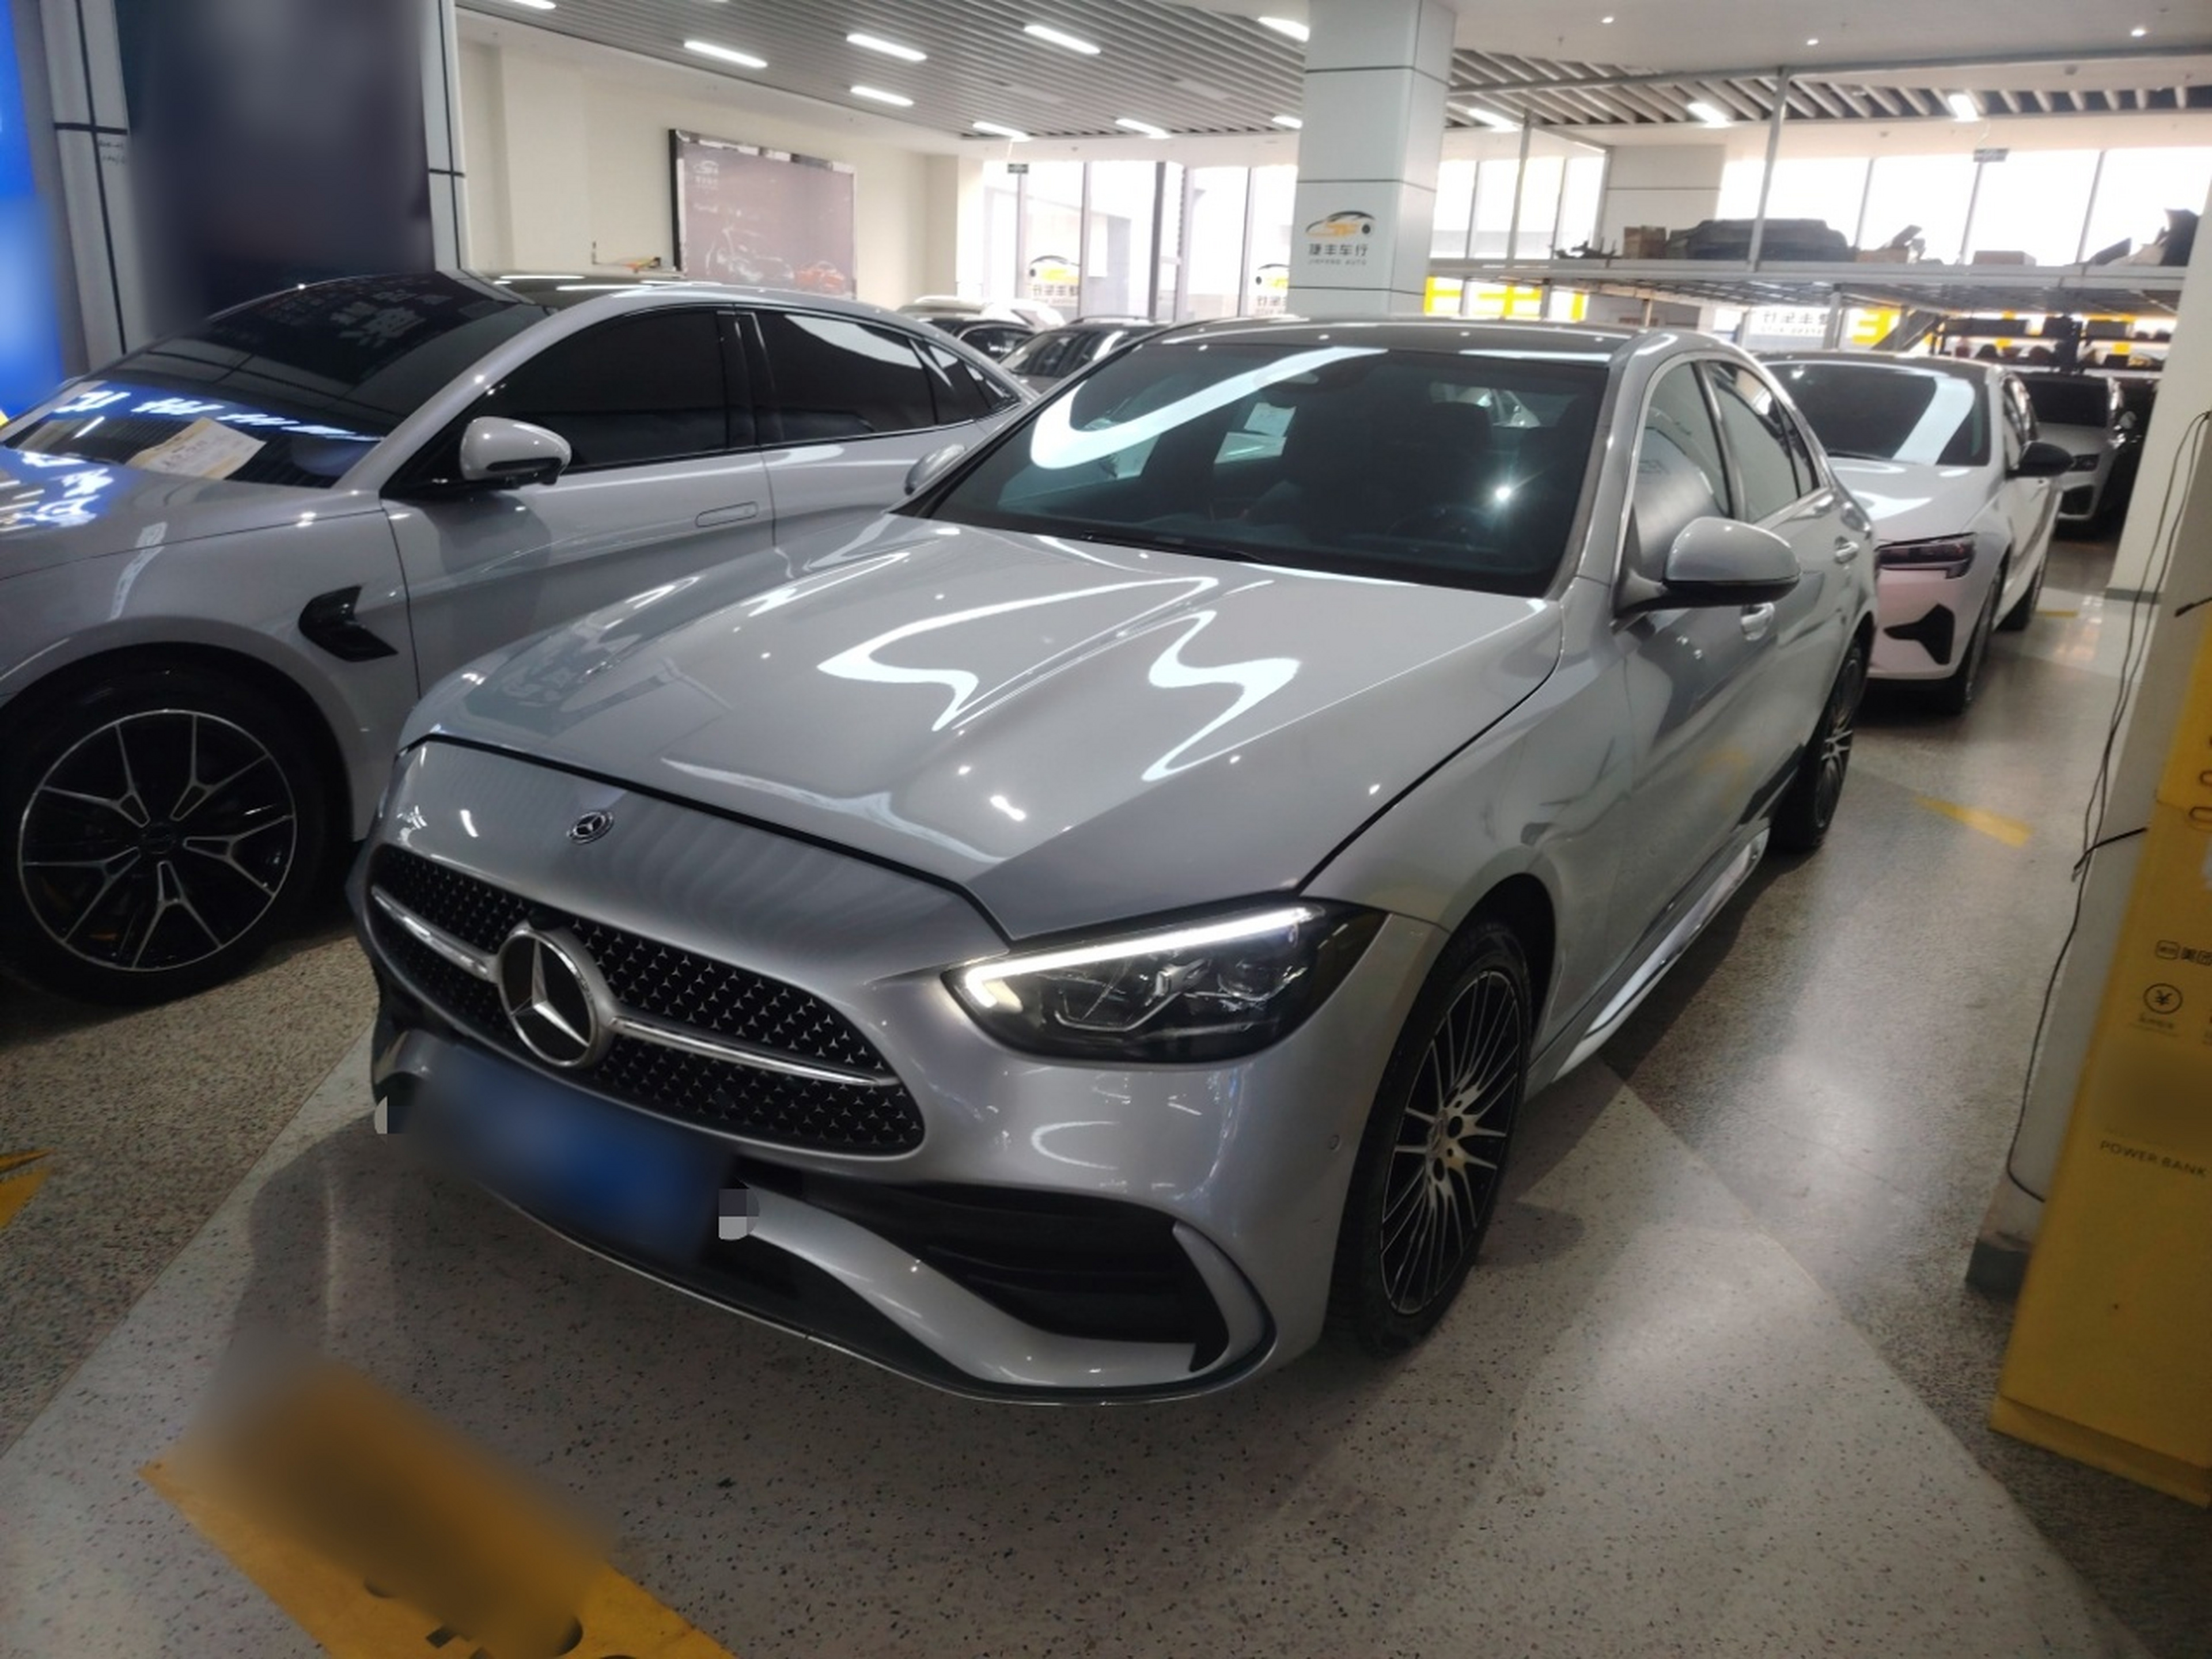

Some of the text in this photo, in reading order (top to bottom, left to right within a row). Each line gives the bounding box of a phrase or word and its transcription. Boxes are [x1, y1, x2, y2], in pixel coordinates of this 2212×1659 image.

[1309, 243, 1369, 256] 捷丰车行
[2100, 1140, 2208, 1178] POWER BANK
